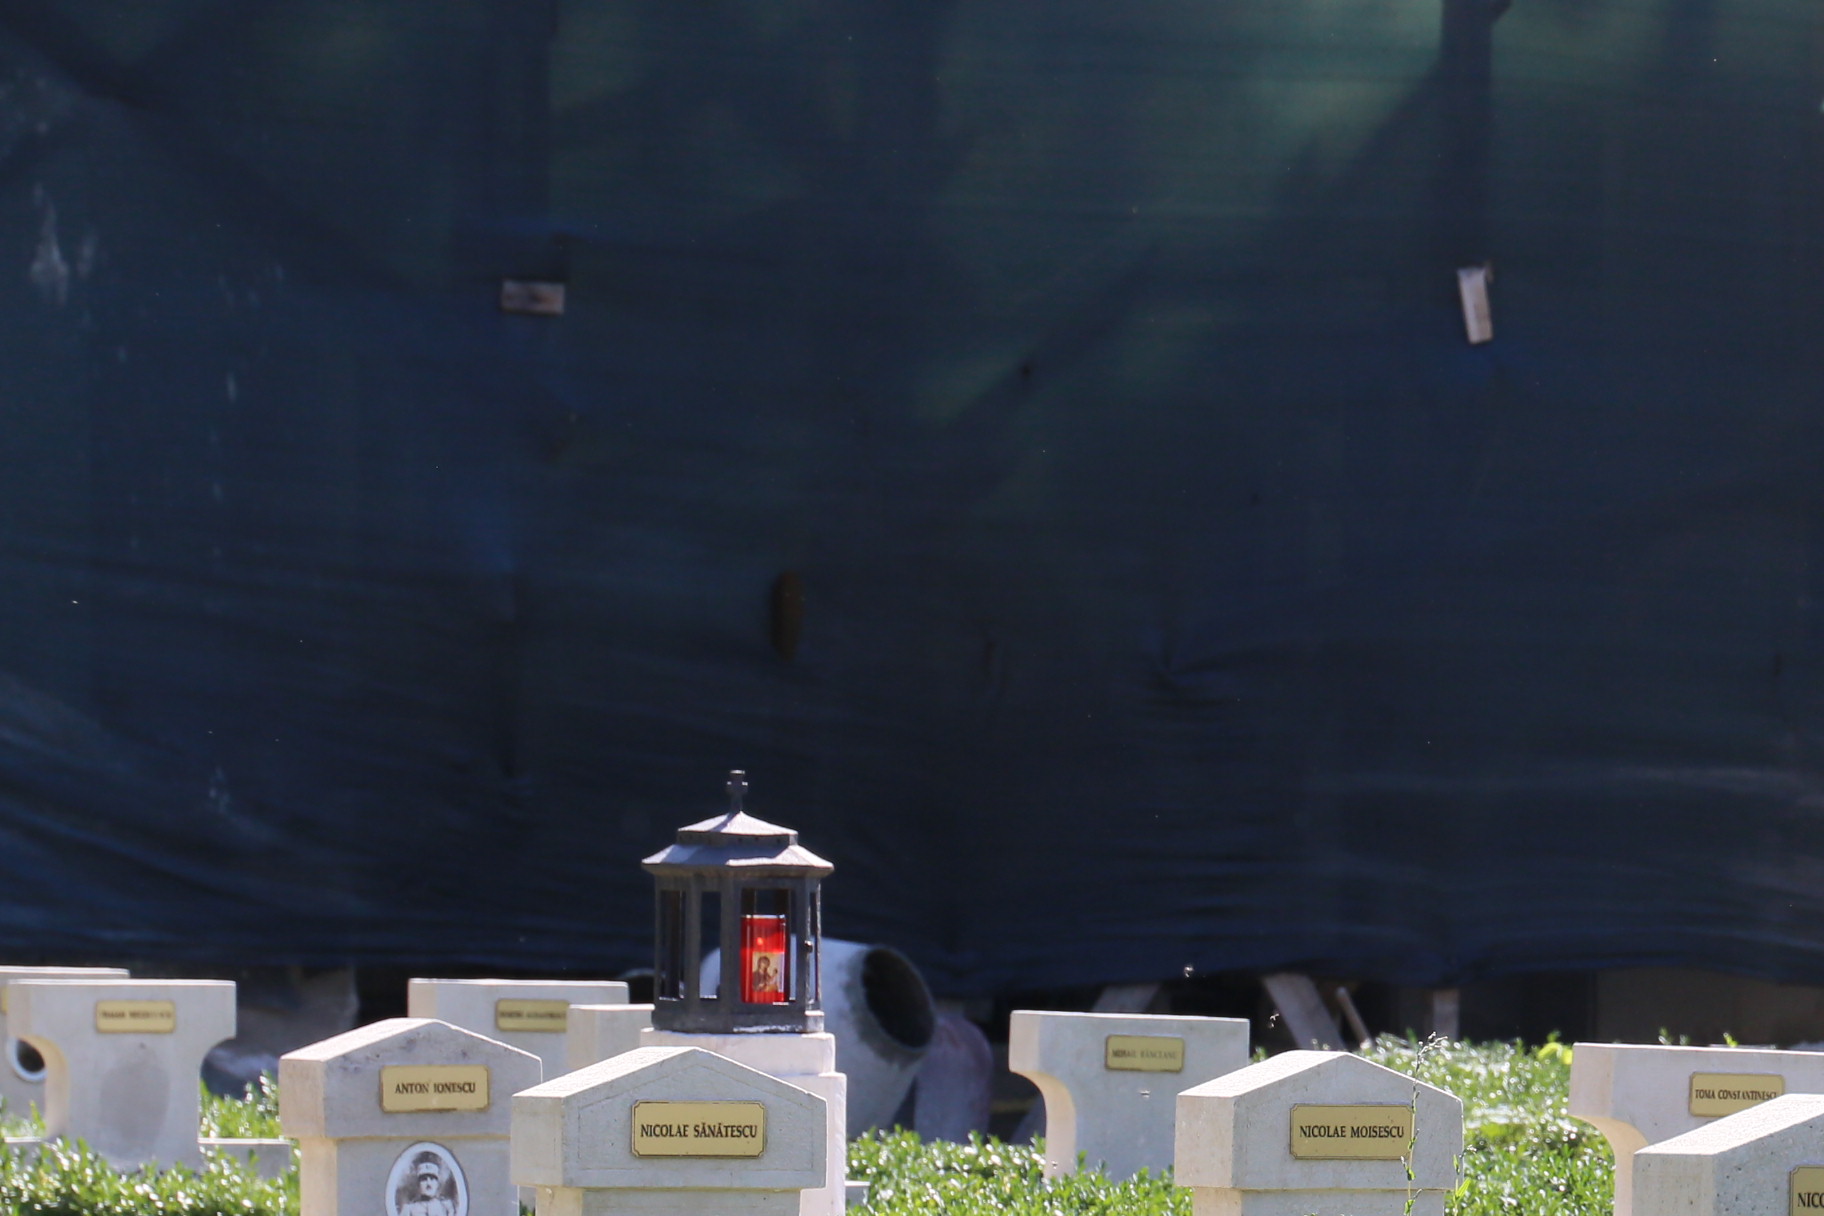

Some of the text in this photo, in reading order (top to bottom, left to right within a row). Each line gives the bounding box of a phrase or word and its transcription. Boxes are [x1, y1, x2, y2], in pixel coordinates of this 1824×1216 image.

[395, 1082, 476, 1094] ANTON IONESCU
[1695, 1089, 1715, 1099] TOMA
[640, 1122, 758, 1138] NICOLAE SĂNĂTESCU
[1299, 1125, 1405, 1139] NICOLAE MOISESCU
